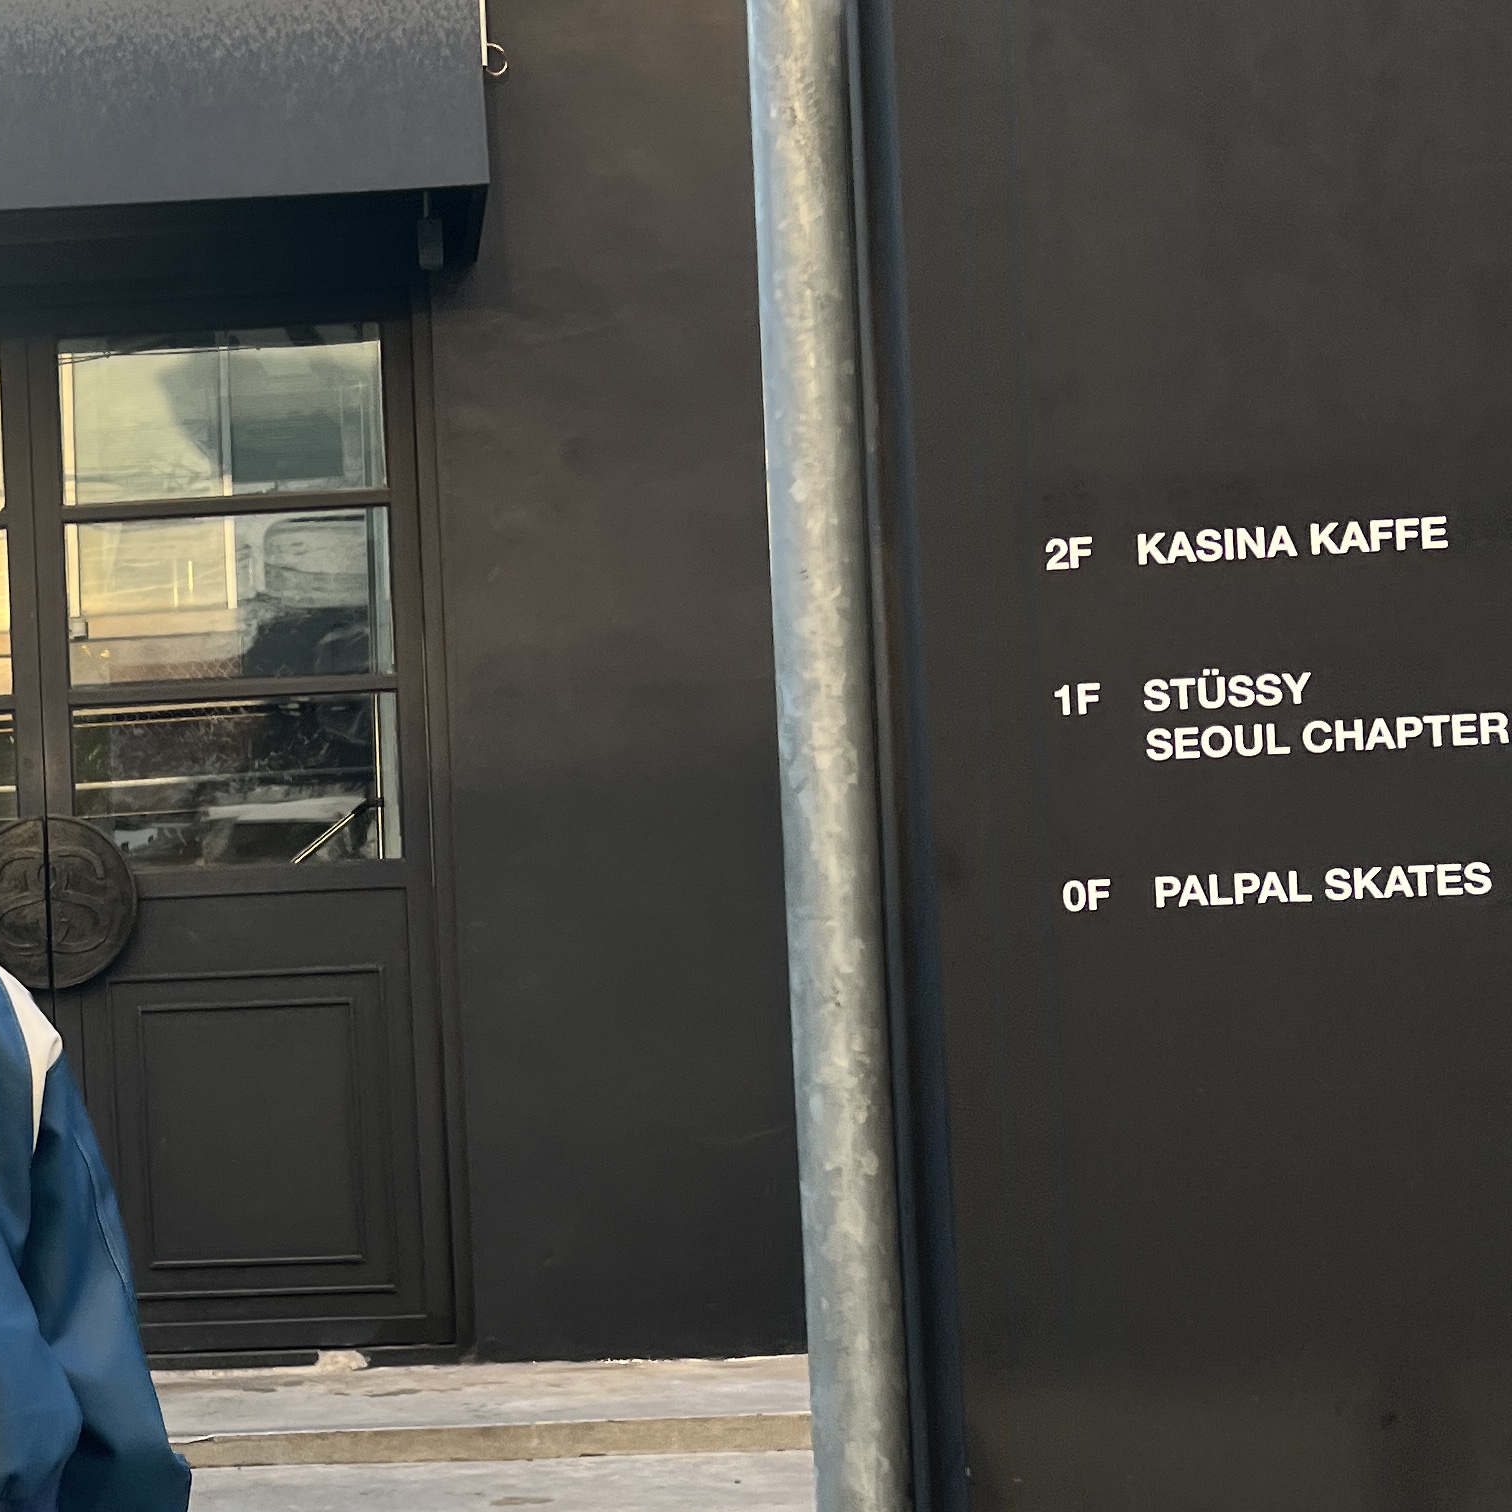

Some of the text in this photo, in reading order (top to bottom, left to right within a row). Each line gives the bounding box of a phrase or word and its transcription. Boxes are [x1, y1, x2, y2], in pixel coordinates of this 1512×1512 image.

[1045, 515, 1449, 571] 2F KASINA KAFFE
[1053, 668, 1312, 716] 1F STÜSSY
[1145, 711, 1510, 761] SEOUL CHAPTER
[1062, 861, 1493, 913] 0F PALPAL SKATES
